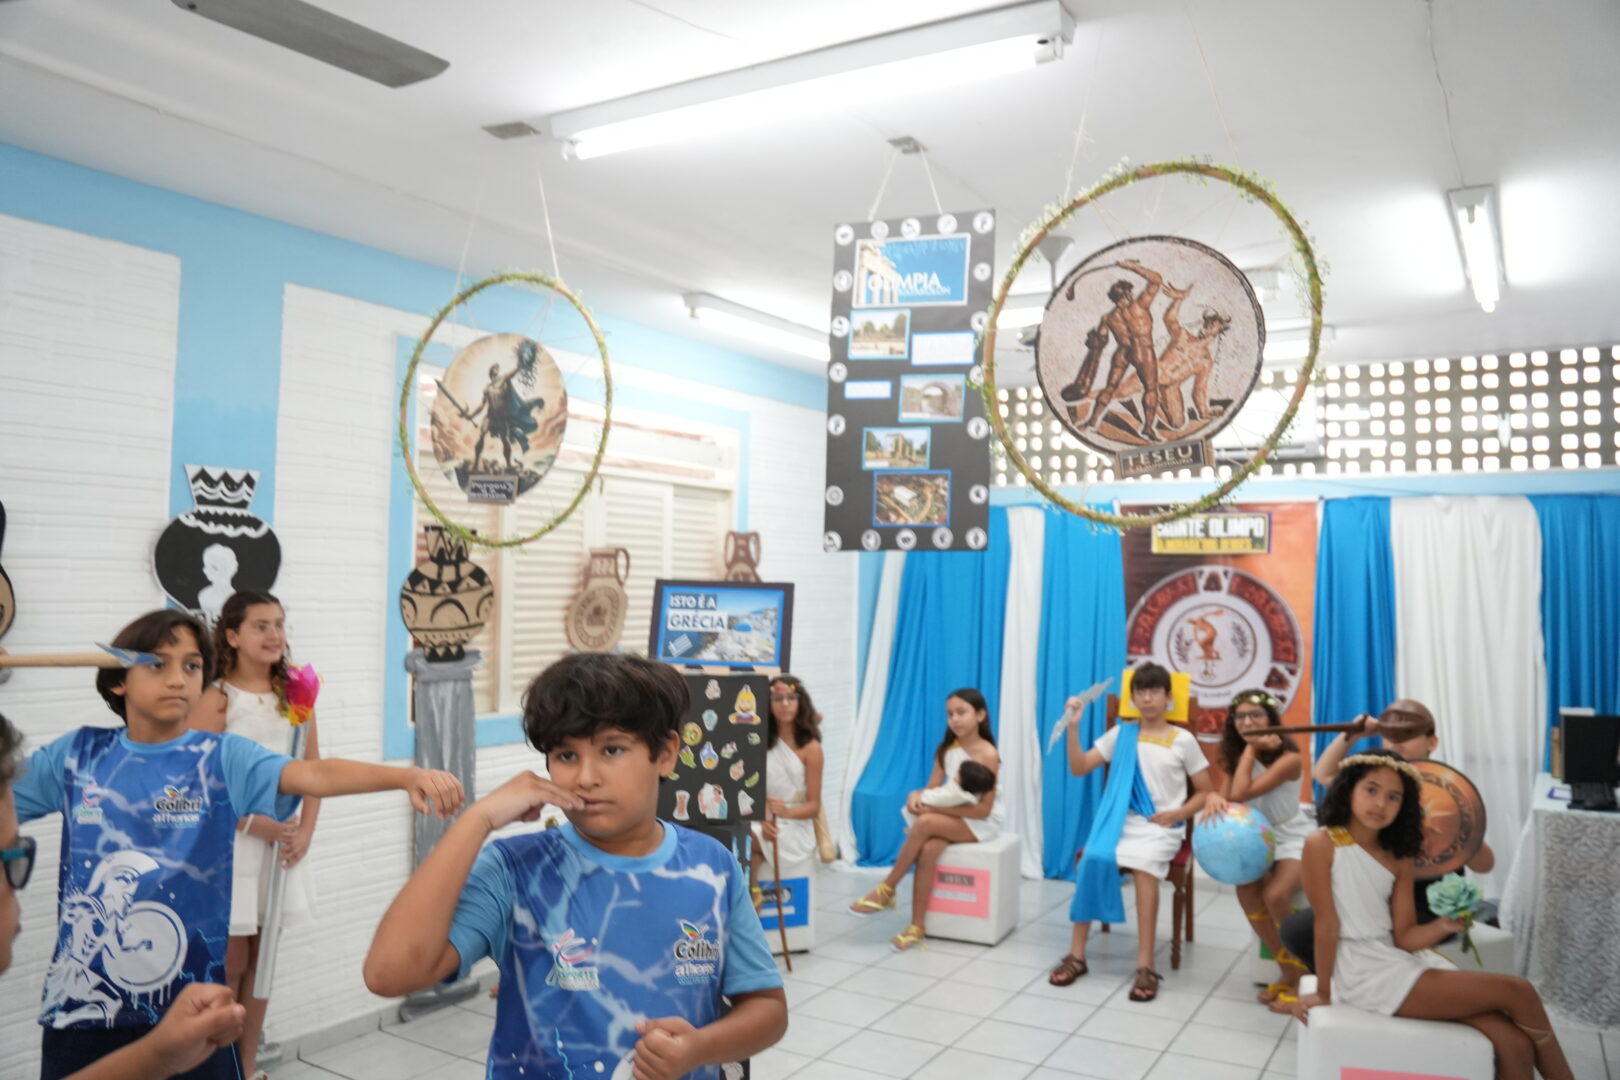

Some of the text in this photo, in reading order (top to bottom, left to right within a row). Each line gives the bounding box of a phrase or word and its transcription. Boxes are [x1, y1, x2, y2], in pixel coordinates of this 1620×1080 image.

[1126, 445, 1193, 467] TESEU
[1208, 516, 1265, 538] OLIMPO
[670, 594, 697, 608] ISTO
[706, 596, 717, 609] A
[155, 797, 203, 813] Colibri
